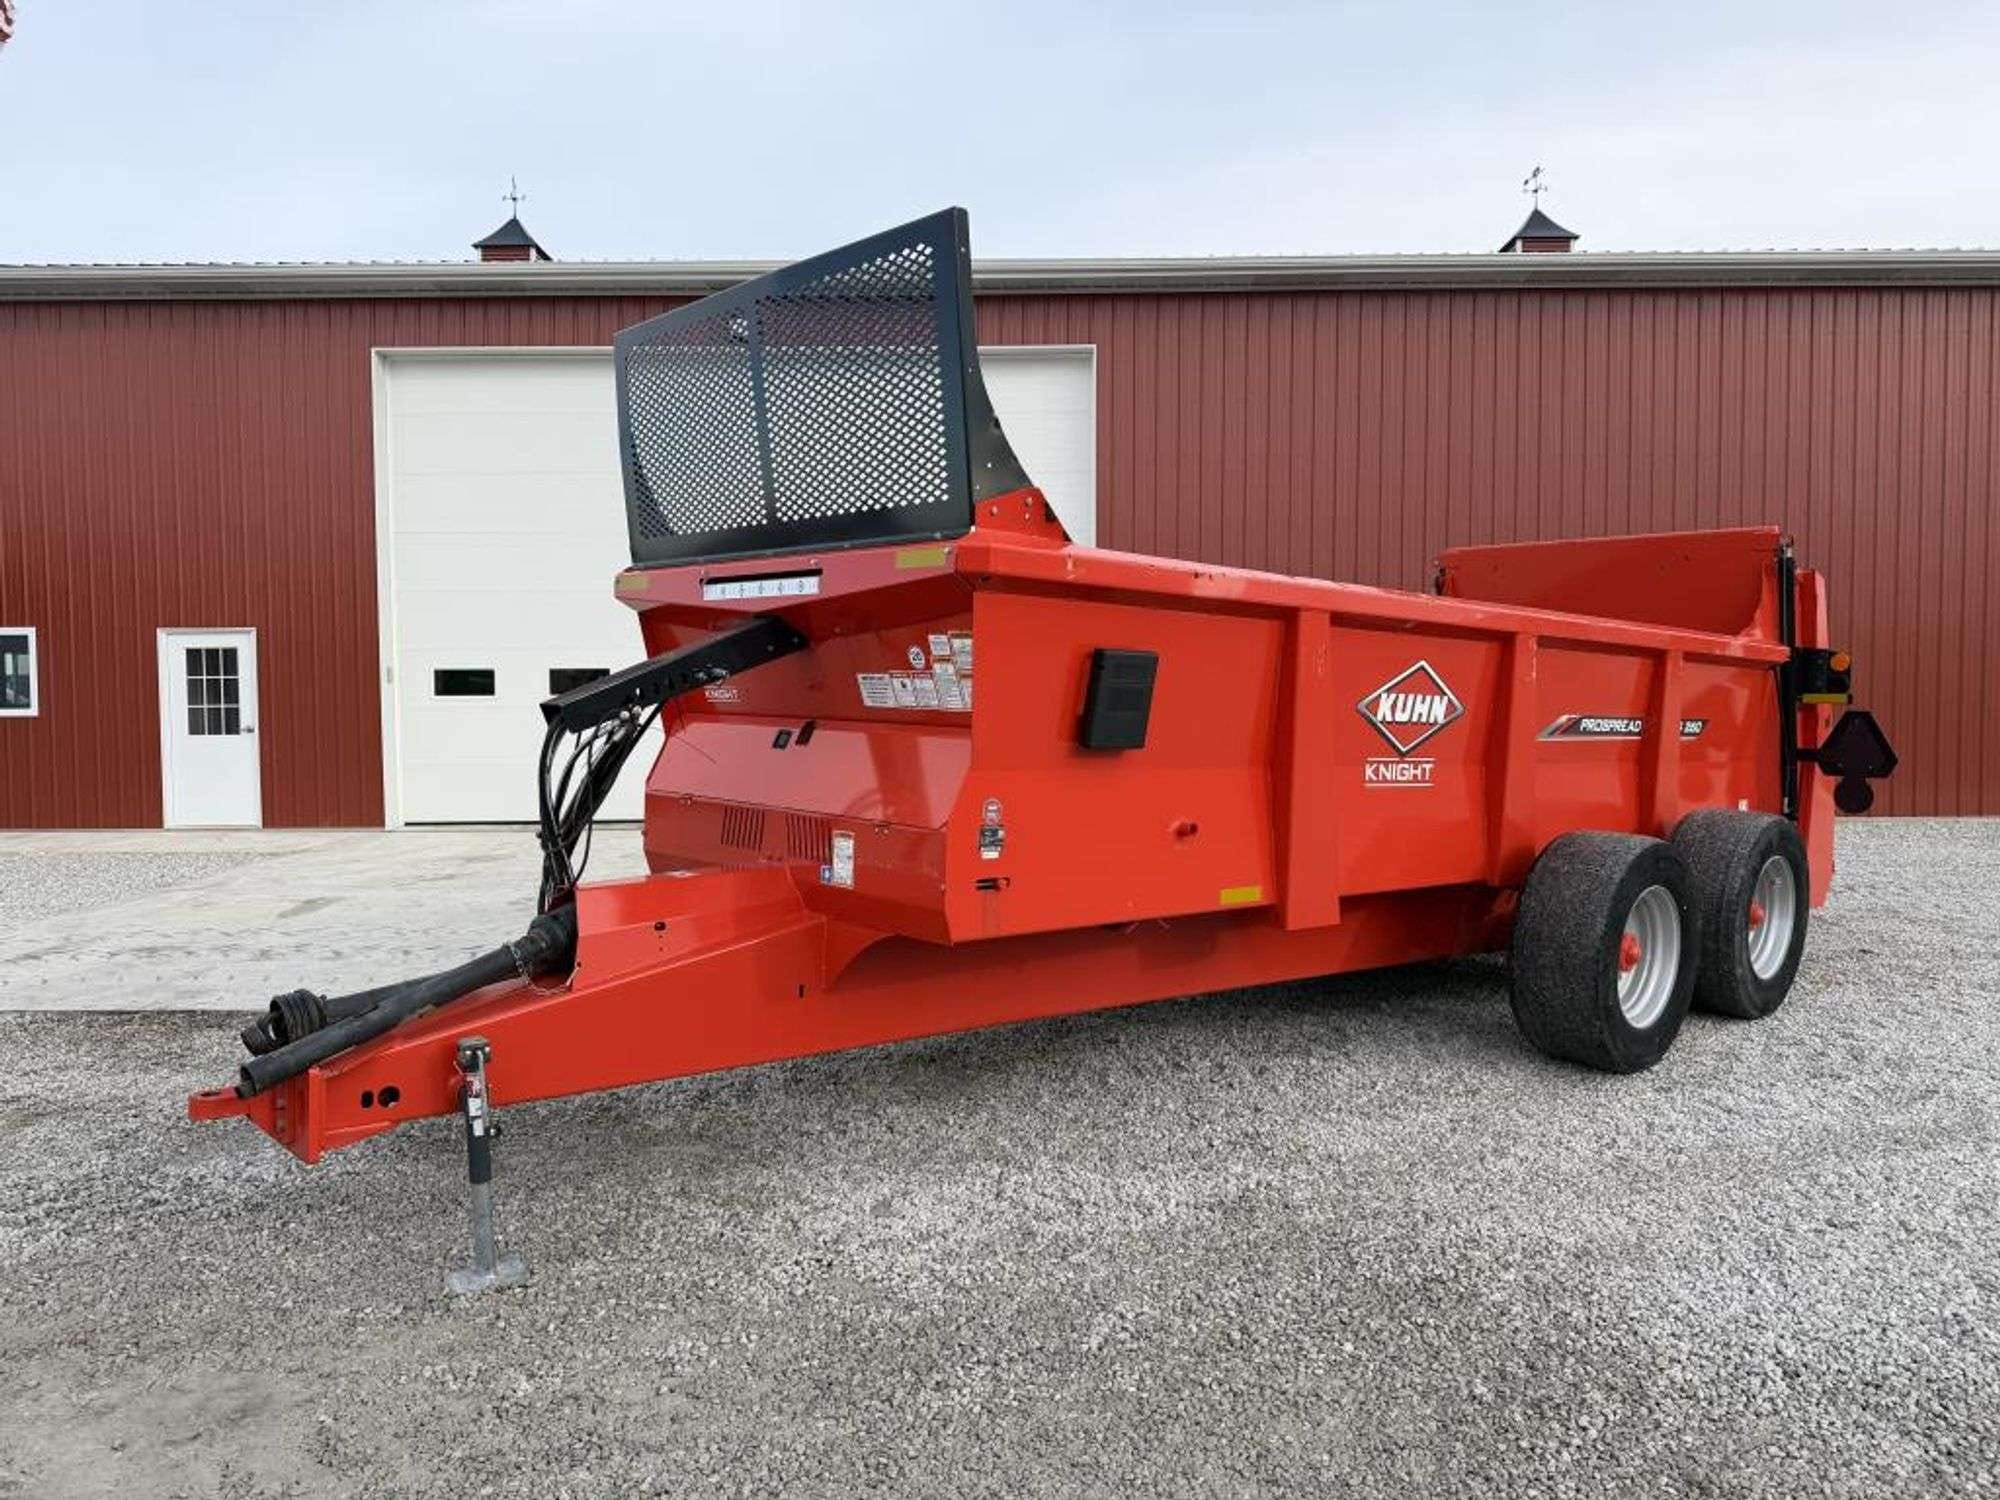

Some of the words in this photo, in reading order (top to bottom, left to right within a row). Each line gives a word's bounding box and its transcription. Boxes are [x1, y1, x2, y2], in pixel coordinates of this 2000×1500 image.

[1377, 693, 1448, 723] KUHN
[1580, 719, 1642, 732] PROSPREAD
[1365, 763, 1433, 781] KNIGHT
